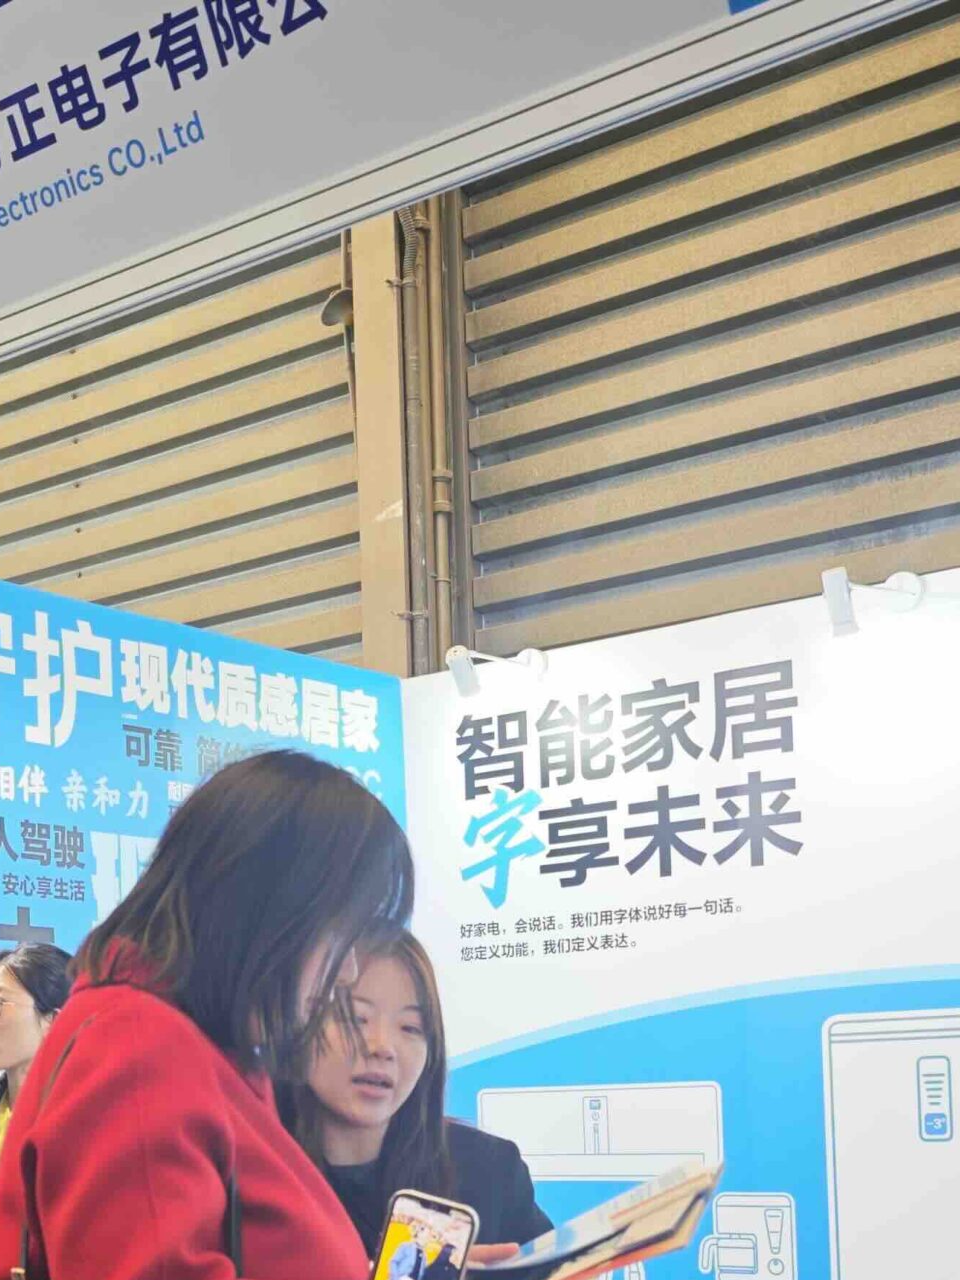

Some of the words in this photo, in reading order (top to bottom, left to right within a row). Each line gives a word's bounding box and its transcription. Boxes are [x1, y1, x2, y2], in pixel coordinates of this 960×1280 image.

[107, 111, 205, 178] CO.,Ltd
[120, 638, 380, 753] 现代质感居家
[122, 724, 182, 772] 可靠
[455, 659, 798, 801] 智能家居
[61, 769, 149, 819] 亲和力
[460, 771, 804, 909] 字享未来
[2, 872, 85, 902] 安心享生活
